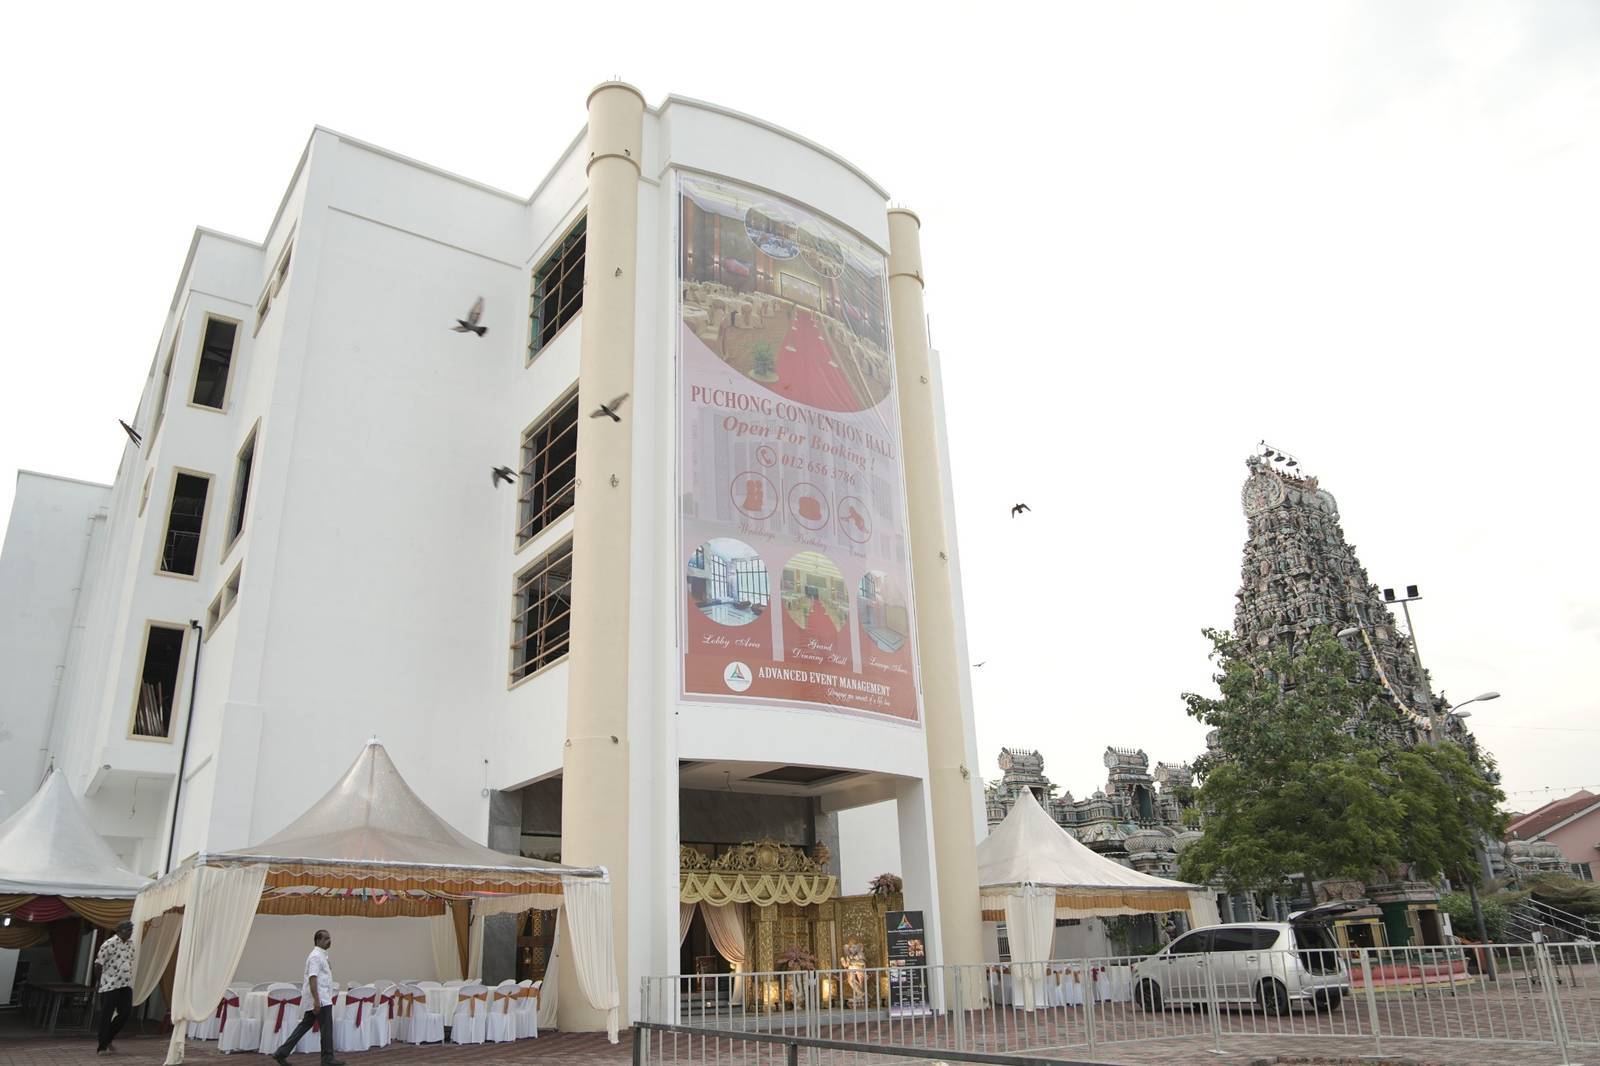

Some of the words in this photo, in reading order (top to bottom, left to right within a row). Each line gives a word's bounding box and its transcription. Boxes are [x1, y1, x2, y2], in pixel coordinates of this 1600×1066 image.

[691, 384, 771, 416] PUCHONG
[776, 402, 864, 446] CONVENTION
[865, 433, 896, 460] HALL
[723, 415, 770, 438] Open
[776, 426, 806, 445] For
[810, 434, 866, 471] Booking
[781, 454, 804, 470] 012
[807, 460, 828, 476] 656
[702, 633, 730, 648] Lobby
[735, 638, 761, 649] Area
[807, 638, 833, 652] Grand
[826, 653, 848, 666] Hall
[758, 665, 808, 683] ADVANCED
[809, 671, 838, 688] EVENT
[839, 676, 891, 698] MANAGEMENT
